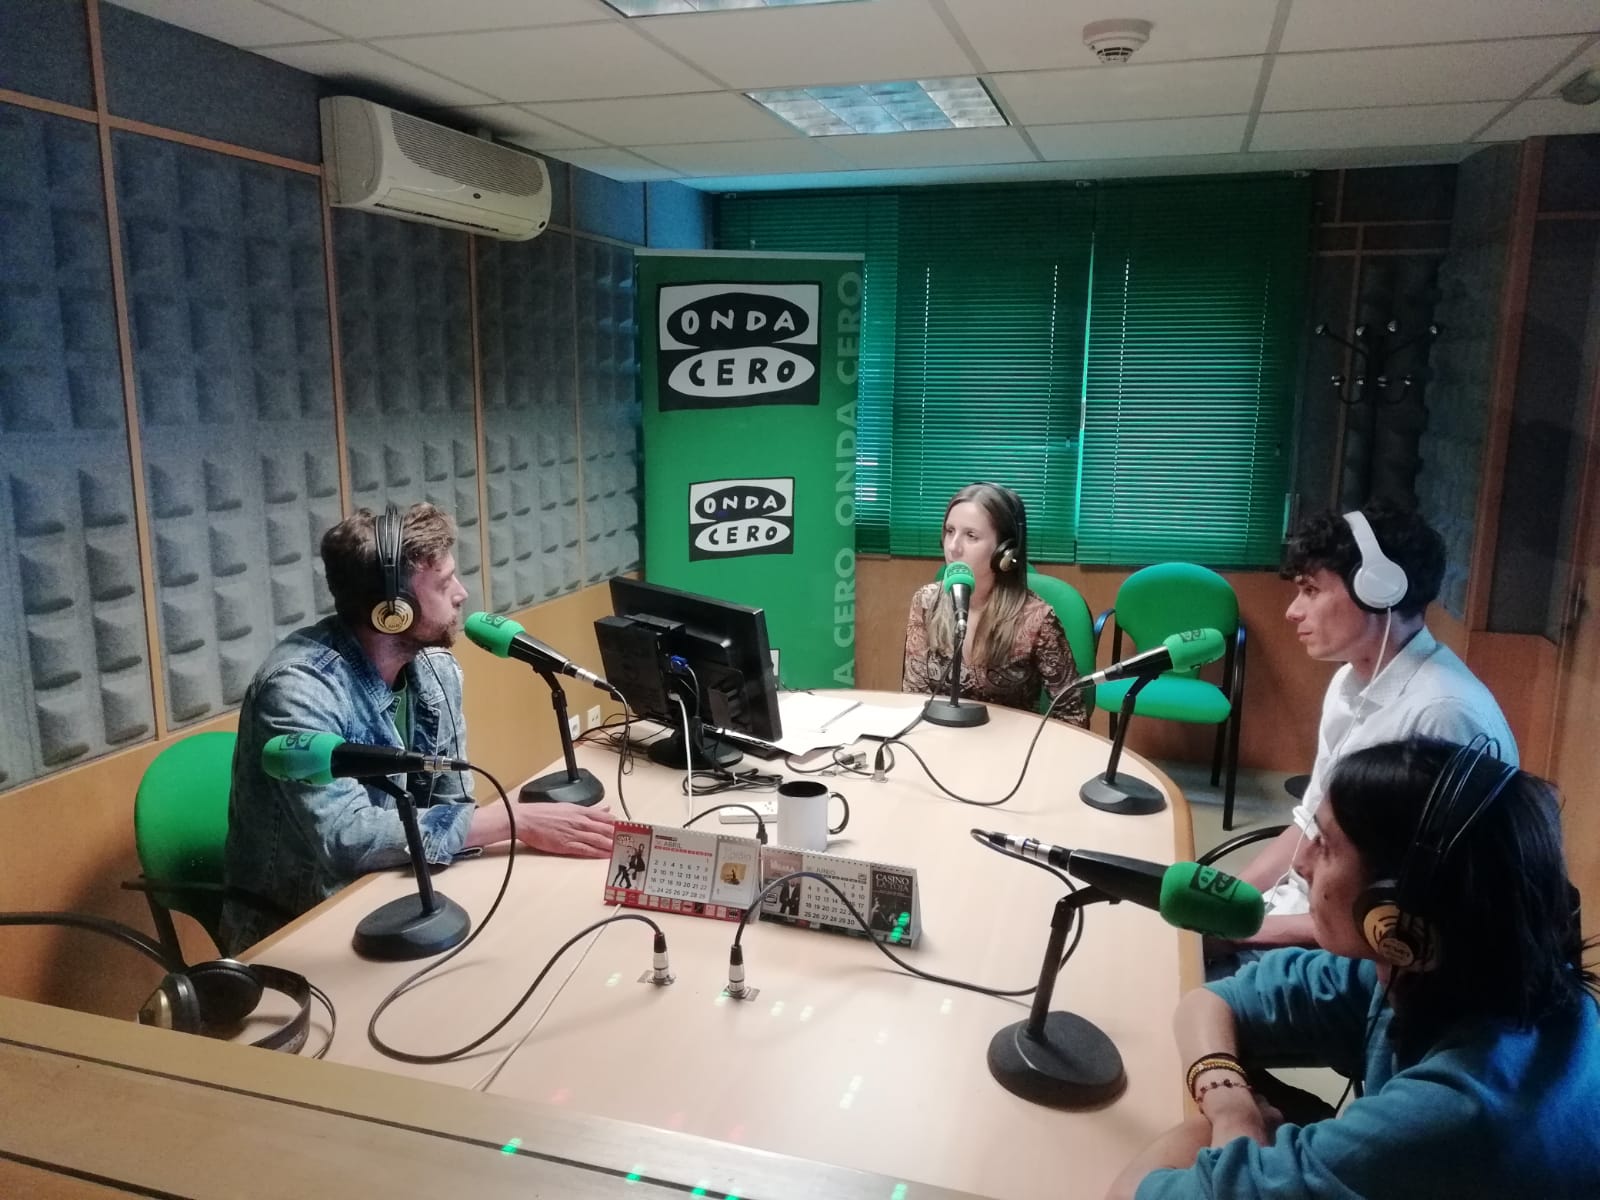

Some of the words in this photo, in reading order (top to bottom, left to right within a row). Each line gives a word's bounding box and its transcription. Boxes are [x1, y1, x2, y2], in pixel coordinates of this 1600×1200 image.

[680, 309, 796, 336] ONDA
[836, 271, 862, 385] CERO
[688, 358, 797, 387] CERO
[835, 400, 859, 527] ONDA
[703, 495, 779, 514] ONDA
[708, 525, 779, 545] CERO
[833, 548, 856, 648] CERO
[876, 873, 910, 886] CASINO
